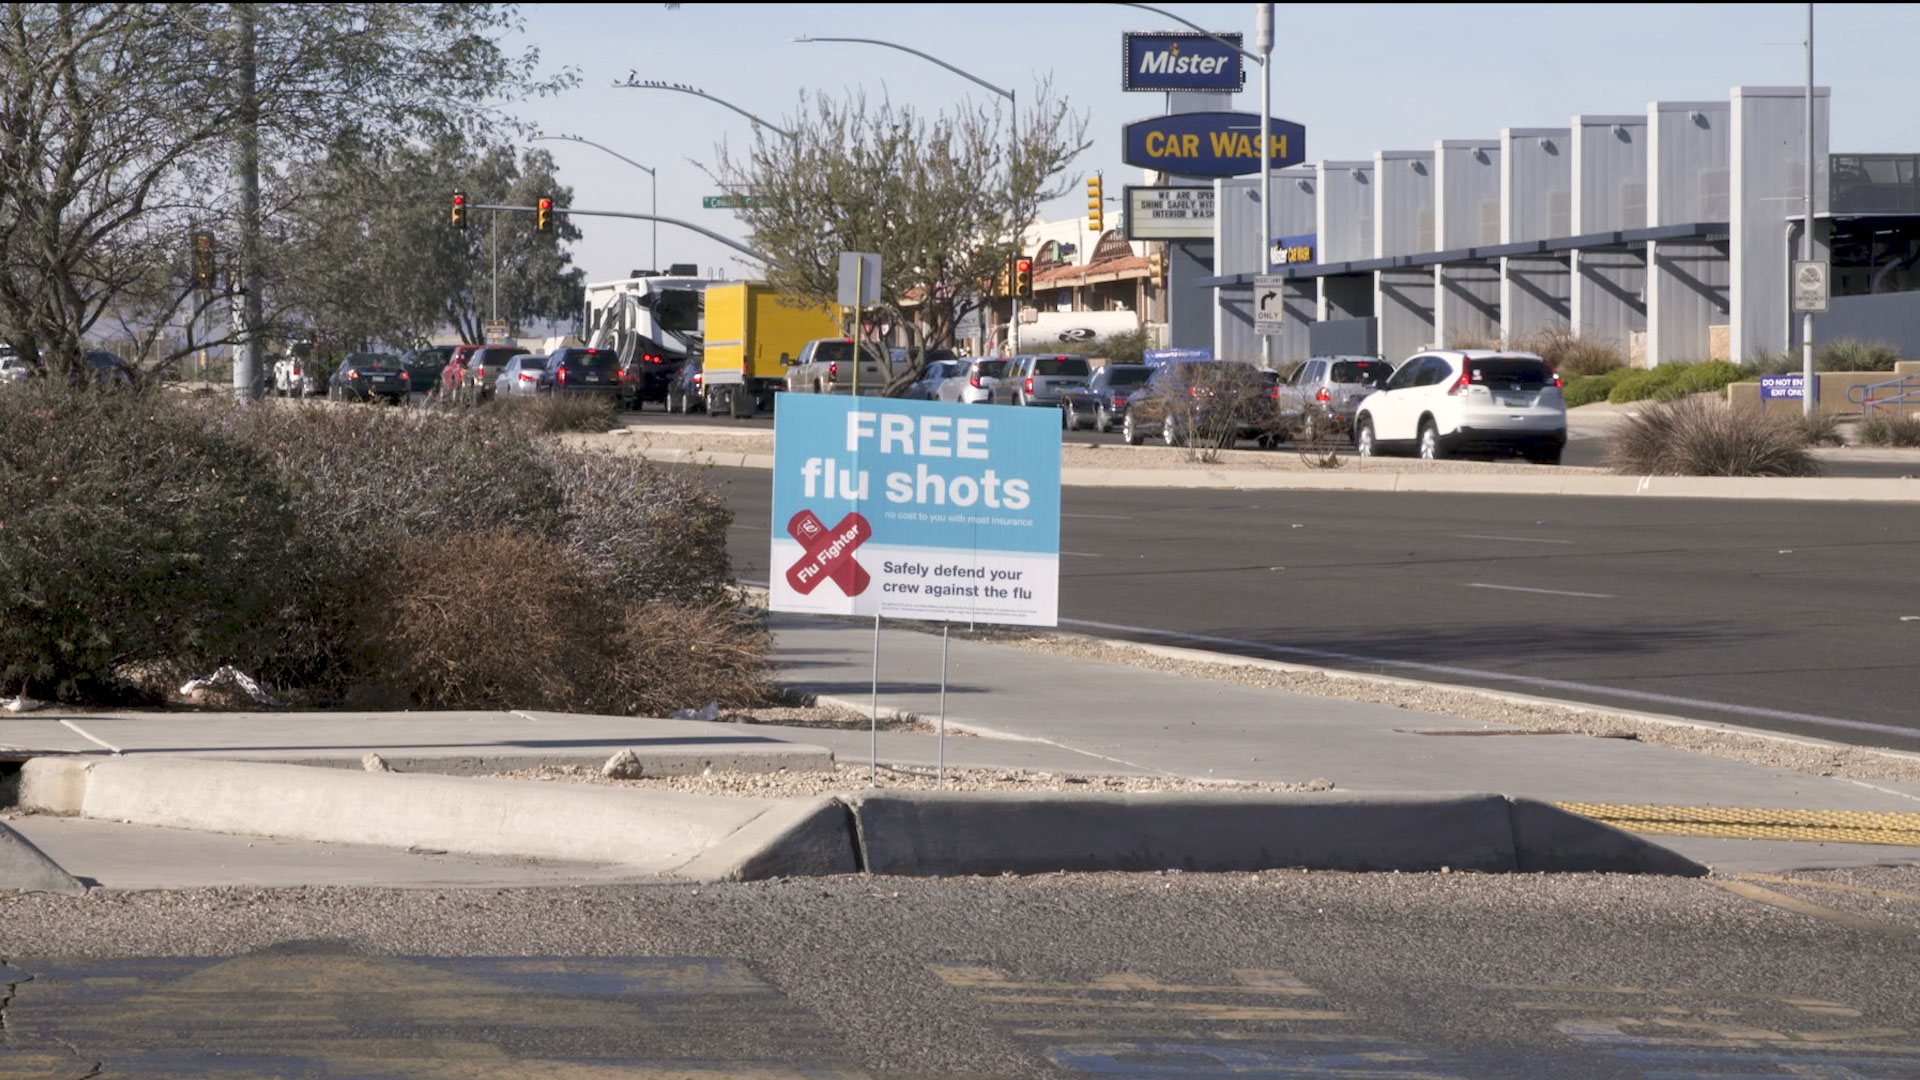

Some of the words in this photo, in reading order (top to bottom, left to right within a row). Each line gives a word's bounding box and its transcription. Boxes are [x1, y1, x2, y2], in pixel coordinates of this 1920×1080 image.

[1139, 45, 1228, 75] Mister
[1145, 131, 1199, 158] CAR
[1141, 201, 1163, 209] SHINE
[1167, 201, 1195, 209] SAFELY
[1199, 201, 1214, 209] WIT
[1158, 192, 1170, 200] WE
[1176, 192, 1190, 200] ARE
[846, 411, 990, 459] FREE
[801, 457, 869, 500] flu
[886, 463, 1031, 510] shots
[898, 512, 917, 520] cost
[918, 512, 928, 521] to
[929, 514, 946, 522] you
[967, 516, 989, 524] most
[991, 517, 1034, 526] insurance
[797, 563, 820, 583] Flu
[816, 525, 859, 565] Fighter
[883, 561, 929, 578] Safely
[934, 564, 986, 579] defend
[990, 568, 1023, 582] your
[883, 582, 920, 593] crew
[924, 584, 980, 598] against
[984, 585, 1008, 598] the
[1012, 587, 1033, 600] flu
